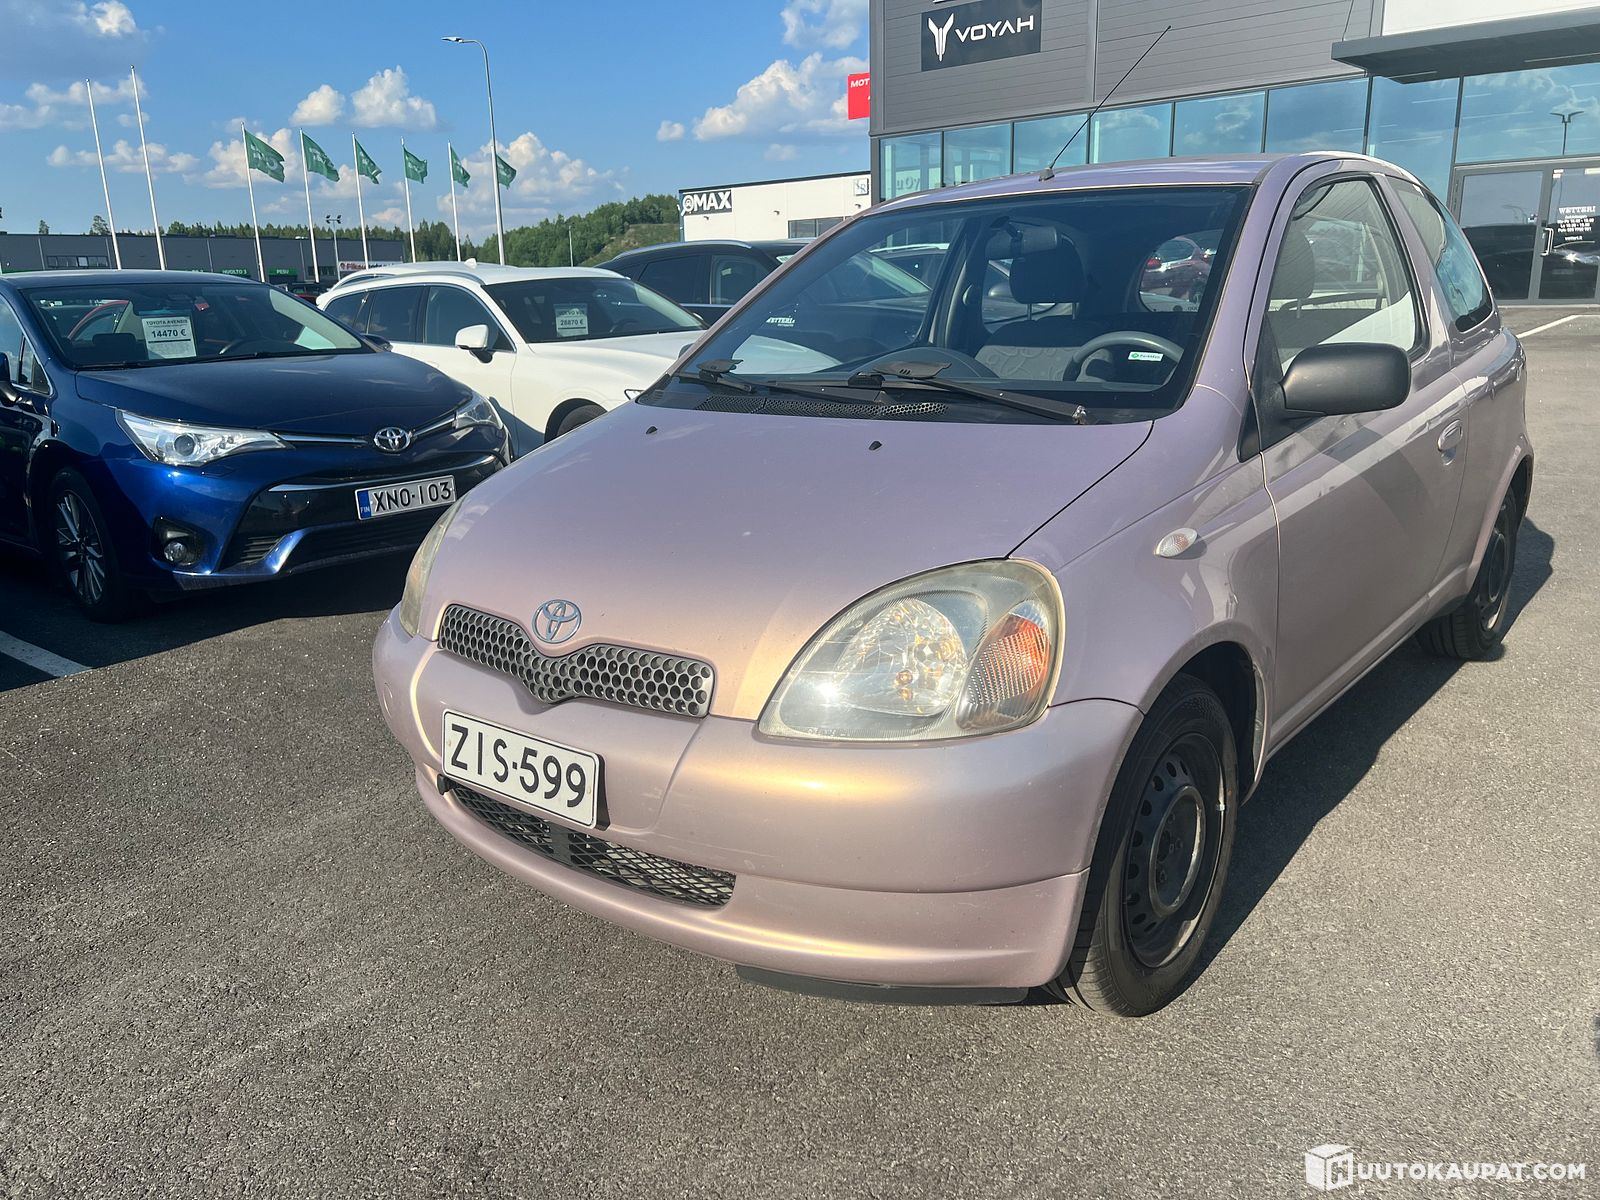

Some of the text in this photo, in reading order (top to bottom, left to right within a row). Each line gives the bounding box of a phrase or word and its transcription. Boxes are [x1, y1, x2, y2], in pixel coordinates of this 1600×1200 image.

[955, 15, 1034, 43] VOYAH
[1559, 206, 1596, 214] WETTERI
[152, 328, 187, 338] 14470 €
[373, 481, 451, 512] XNO-103
[450, 723, 586, 808] ZIS-599
